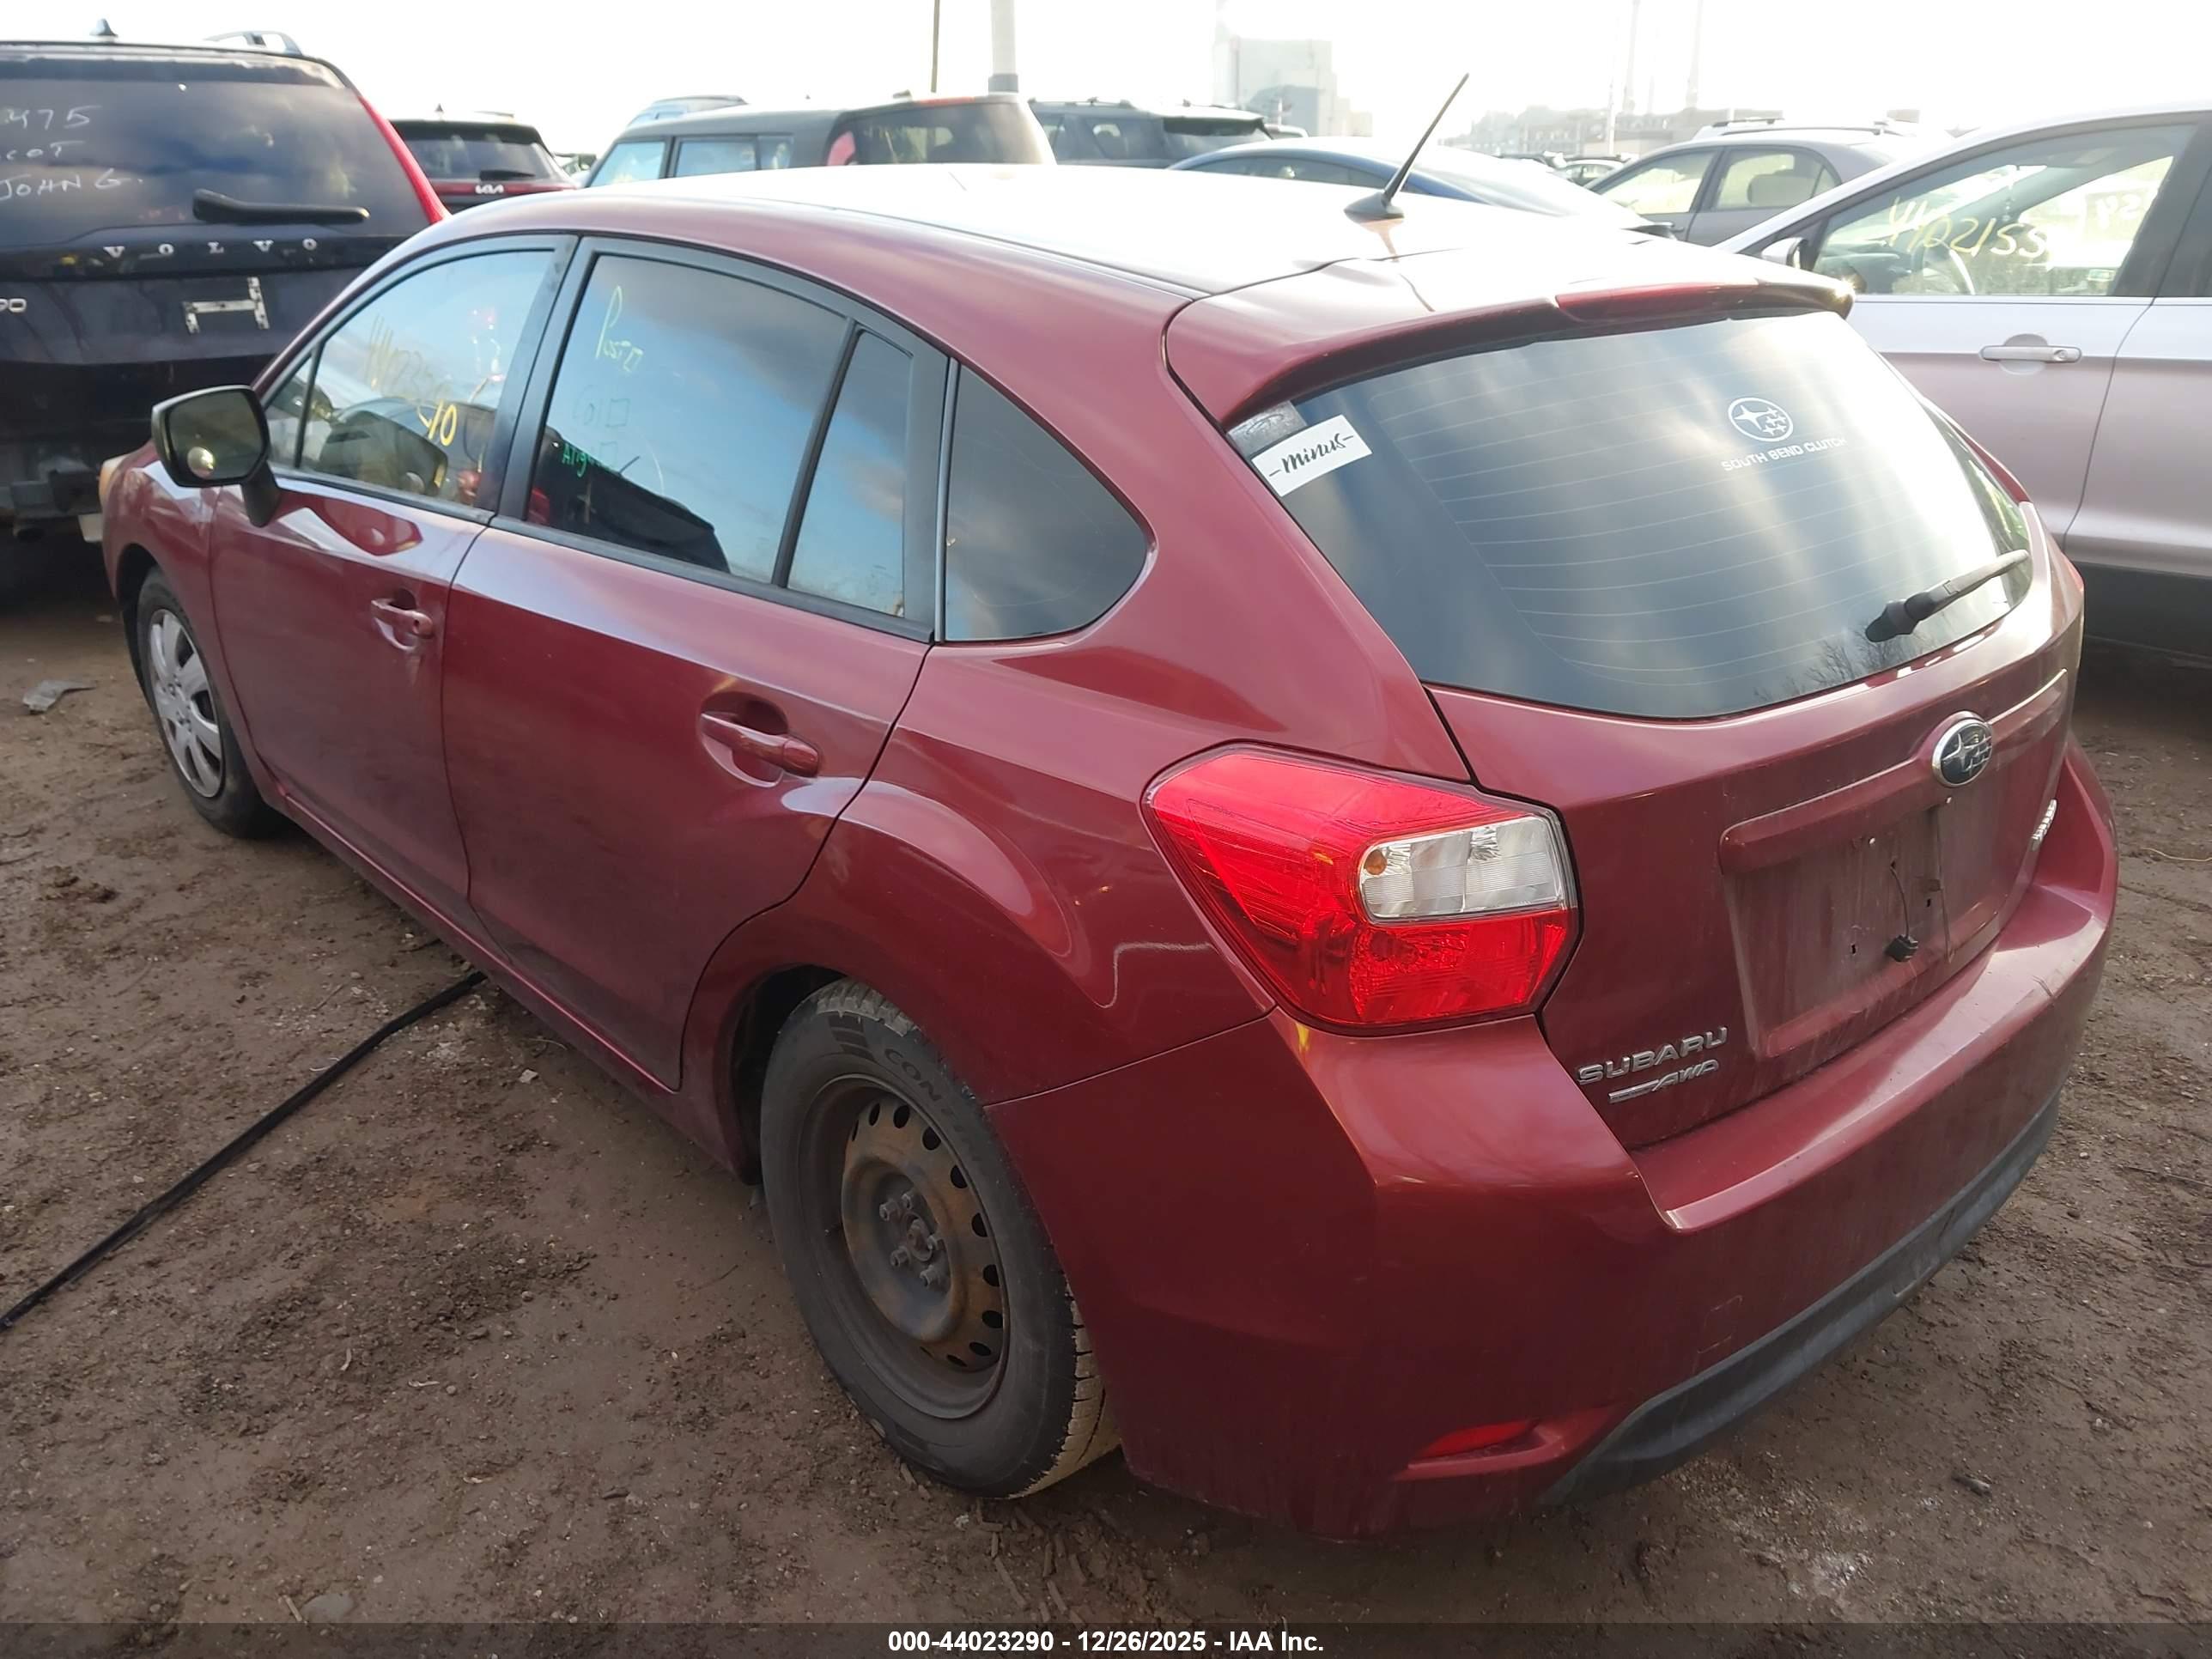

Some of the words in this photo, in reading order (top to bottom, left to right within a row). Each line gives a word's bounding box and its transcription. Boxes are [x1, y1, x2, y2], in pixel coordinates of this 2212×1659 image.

[102, 238, 318, 258] VOLVO
[1721, 453, 1769, 472] SOUTH
[1767, 444, 1804, 461] BEND
[1803, 436, 1850, 453] CLUTCH
[1577, 1026, 1729, 1086] SUBARU
[1651, 1058, 1720, 1092] AWD
